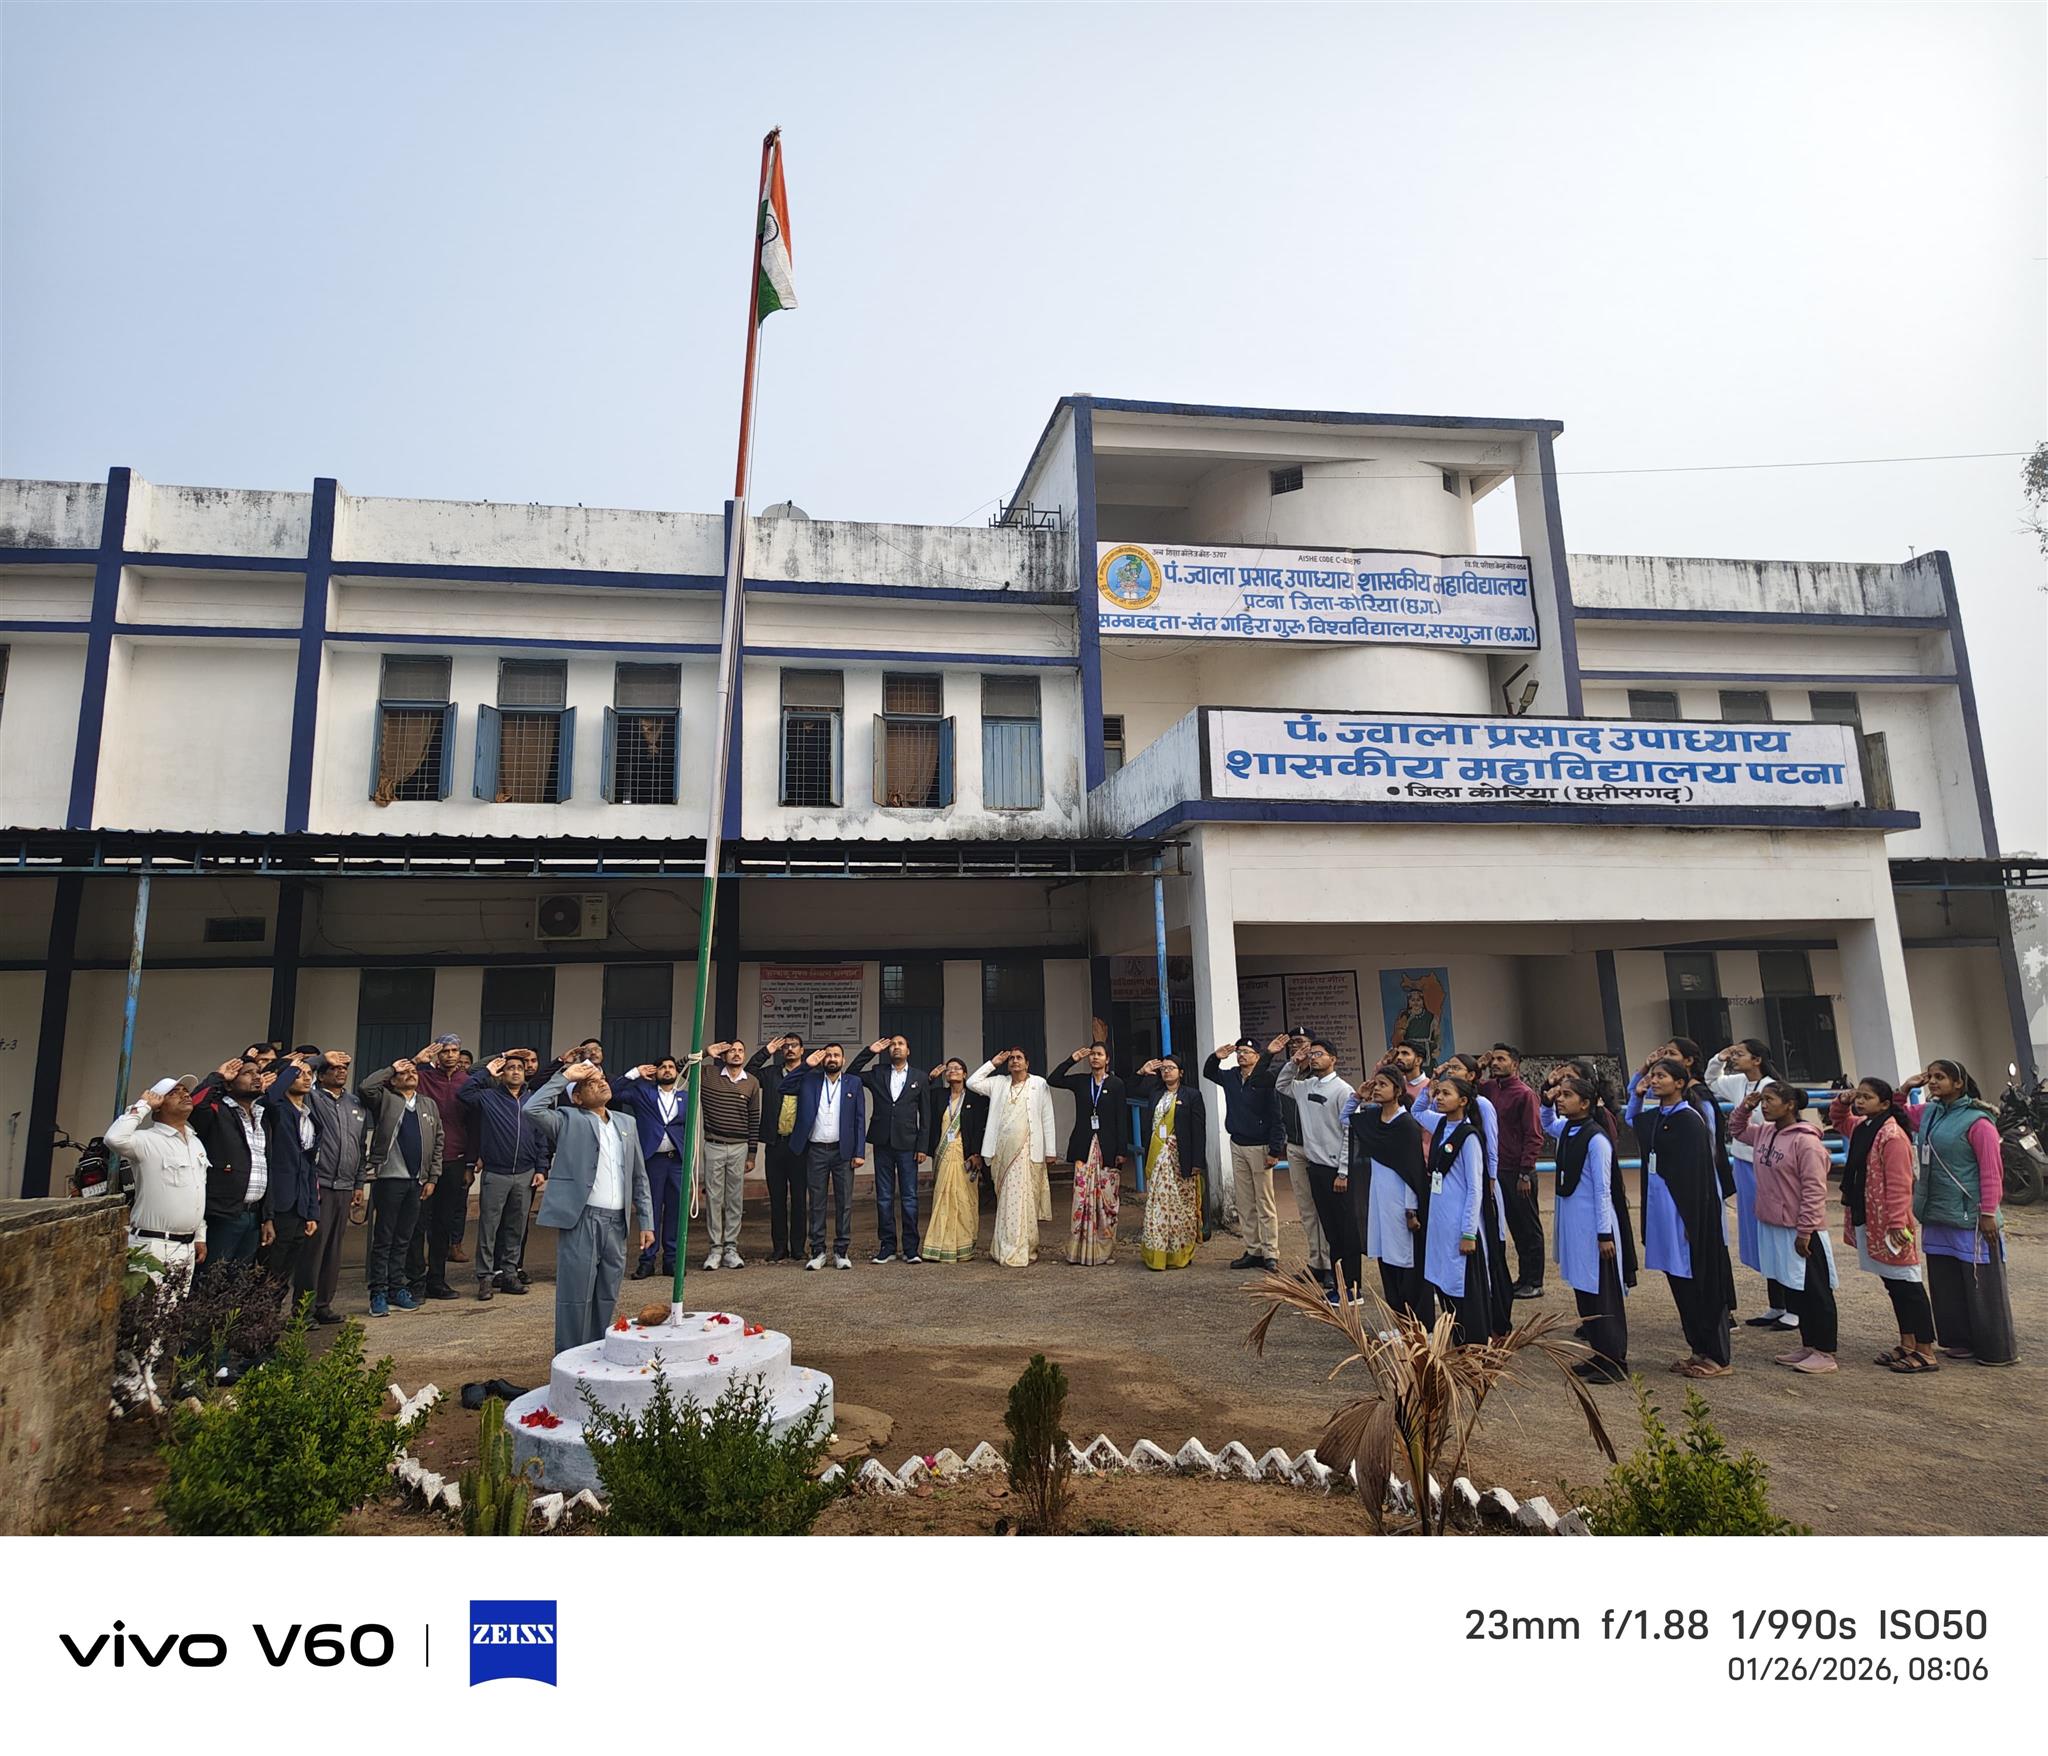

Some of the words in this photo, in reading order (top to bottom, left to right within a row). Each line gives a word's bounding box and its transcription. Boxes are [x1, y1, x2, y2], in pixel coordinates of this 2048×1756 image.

[1238, 567, 1284, 589] प्रसाद
[1285, 569, 1353, 589] उपाध्याय
[1357, 567, 1431, 592] शासकीय
[1433, 571, 1527, 597] महाविद्यालय
[1243, 593, 1284, 609] पटना
[1221, 613, 1271, 635] गहिरा
[1284, 714, 1327, 743] पं.
[1336, 722, 1480, 747] ज्वाला
[1484, 724, 1604, 753] प्रसाद
[1609, 728, 1791, 753] उपाध्याय
[1226, 747, 1450, 779] शासकीय
[1457, 751, 1742, 786] महाविद्यालय
[1746, 763, 1846, 785] पटना
[1404, 782, 1463, 799] जिला
[1467, 782, 1559, 800] कोरिया
